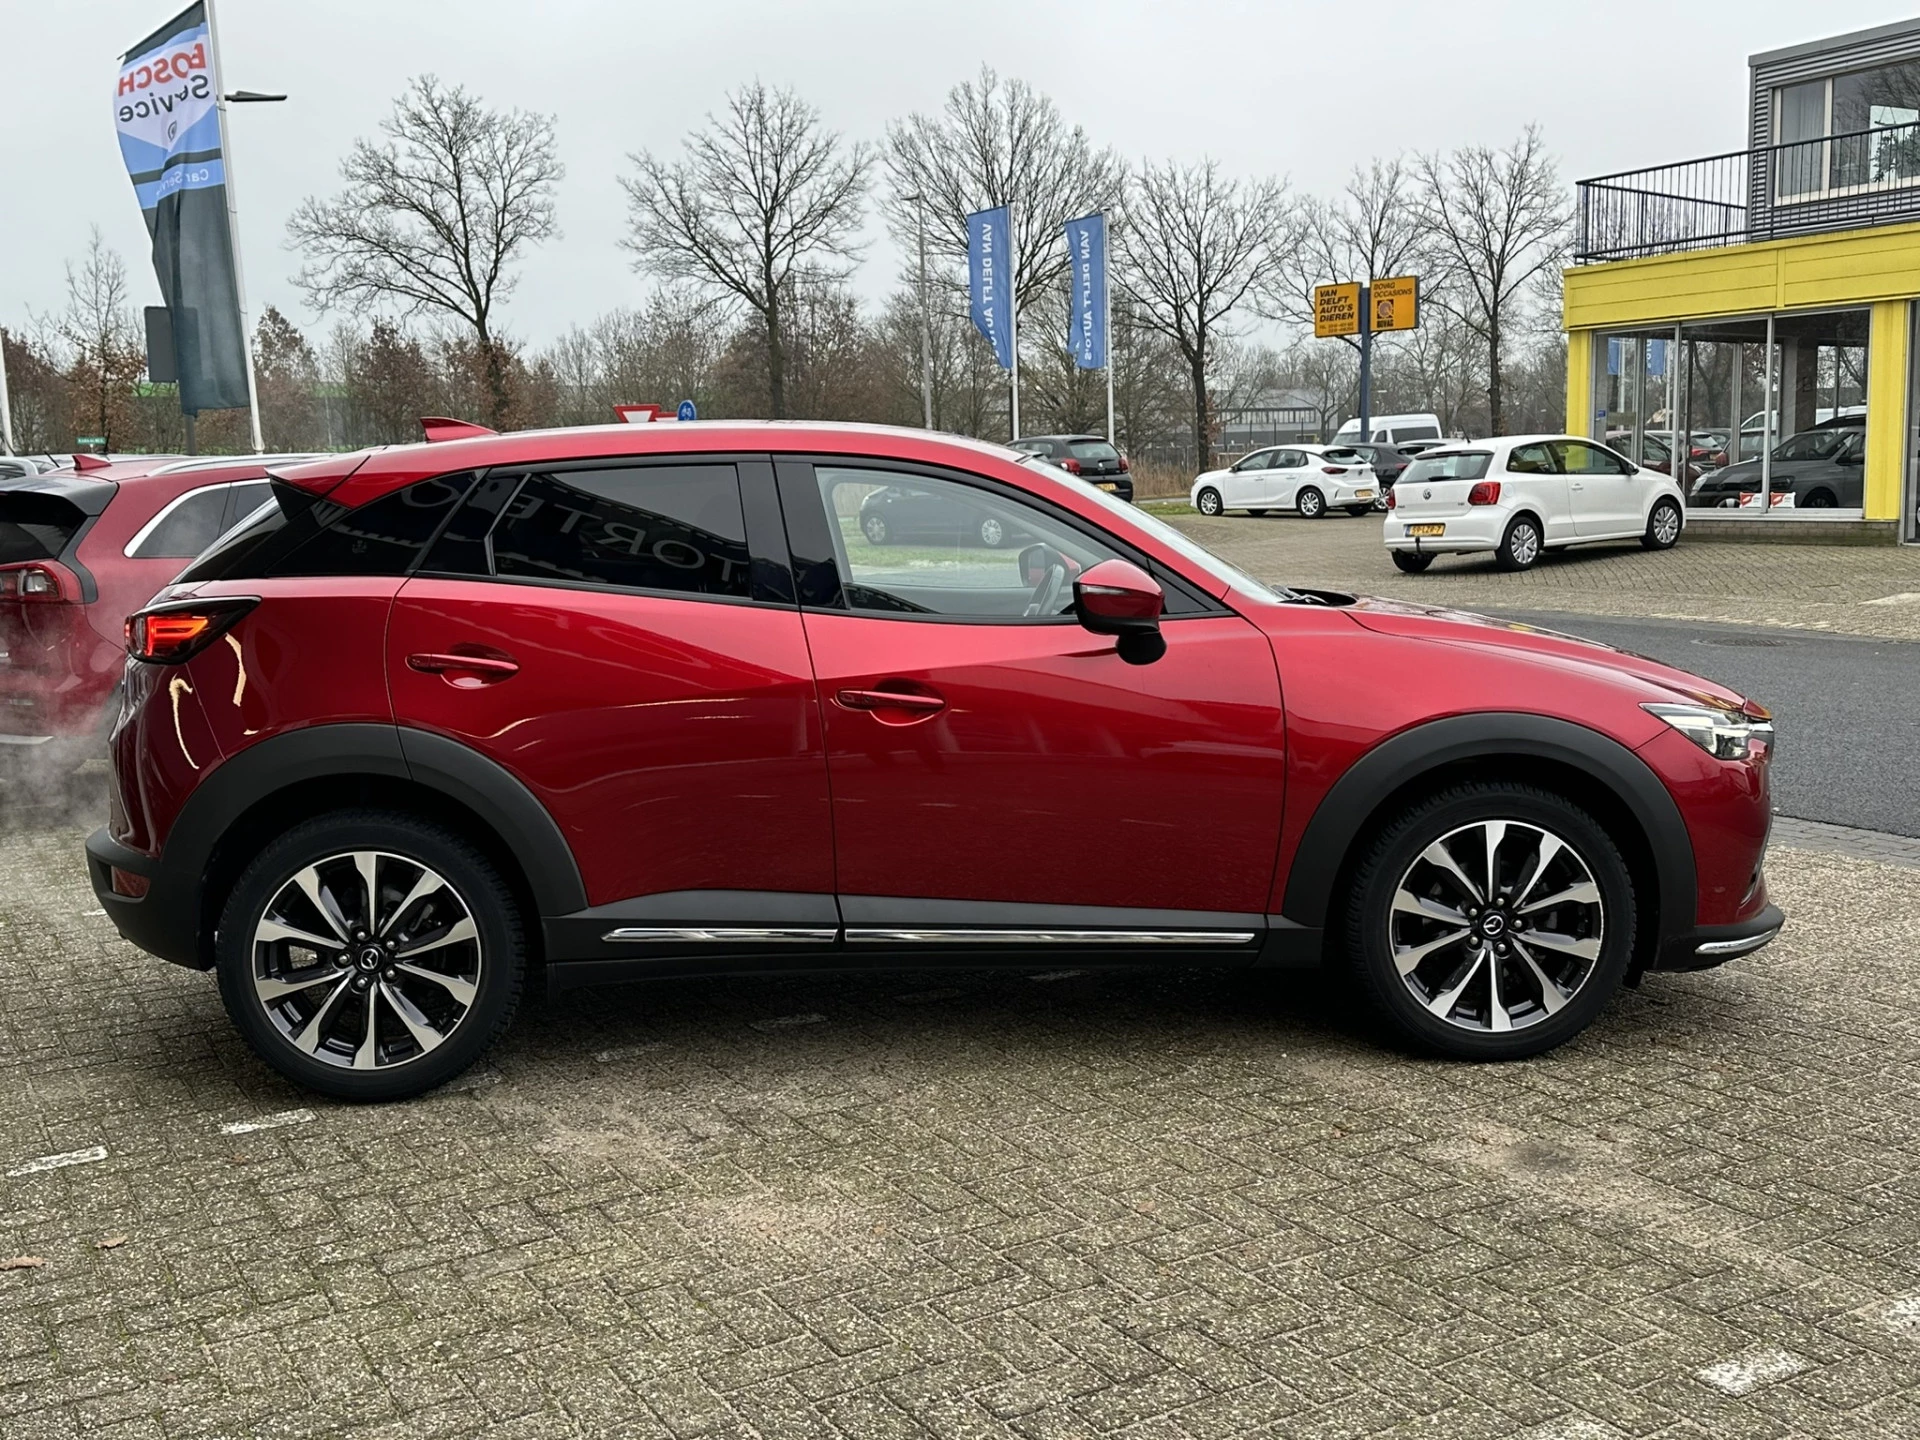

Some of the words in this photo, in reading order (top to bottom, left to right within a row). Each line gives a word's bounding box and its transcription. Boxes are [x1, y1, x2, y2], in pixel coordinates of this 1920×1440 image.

[1320, 289, 1337, 298] VAN
[1319, 296, 1349, 306] DELFT
[1319, 304, 1353, 314] AUTO'S
[1319, 312, 1354, 323] DIEREN
